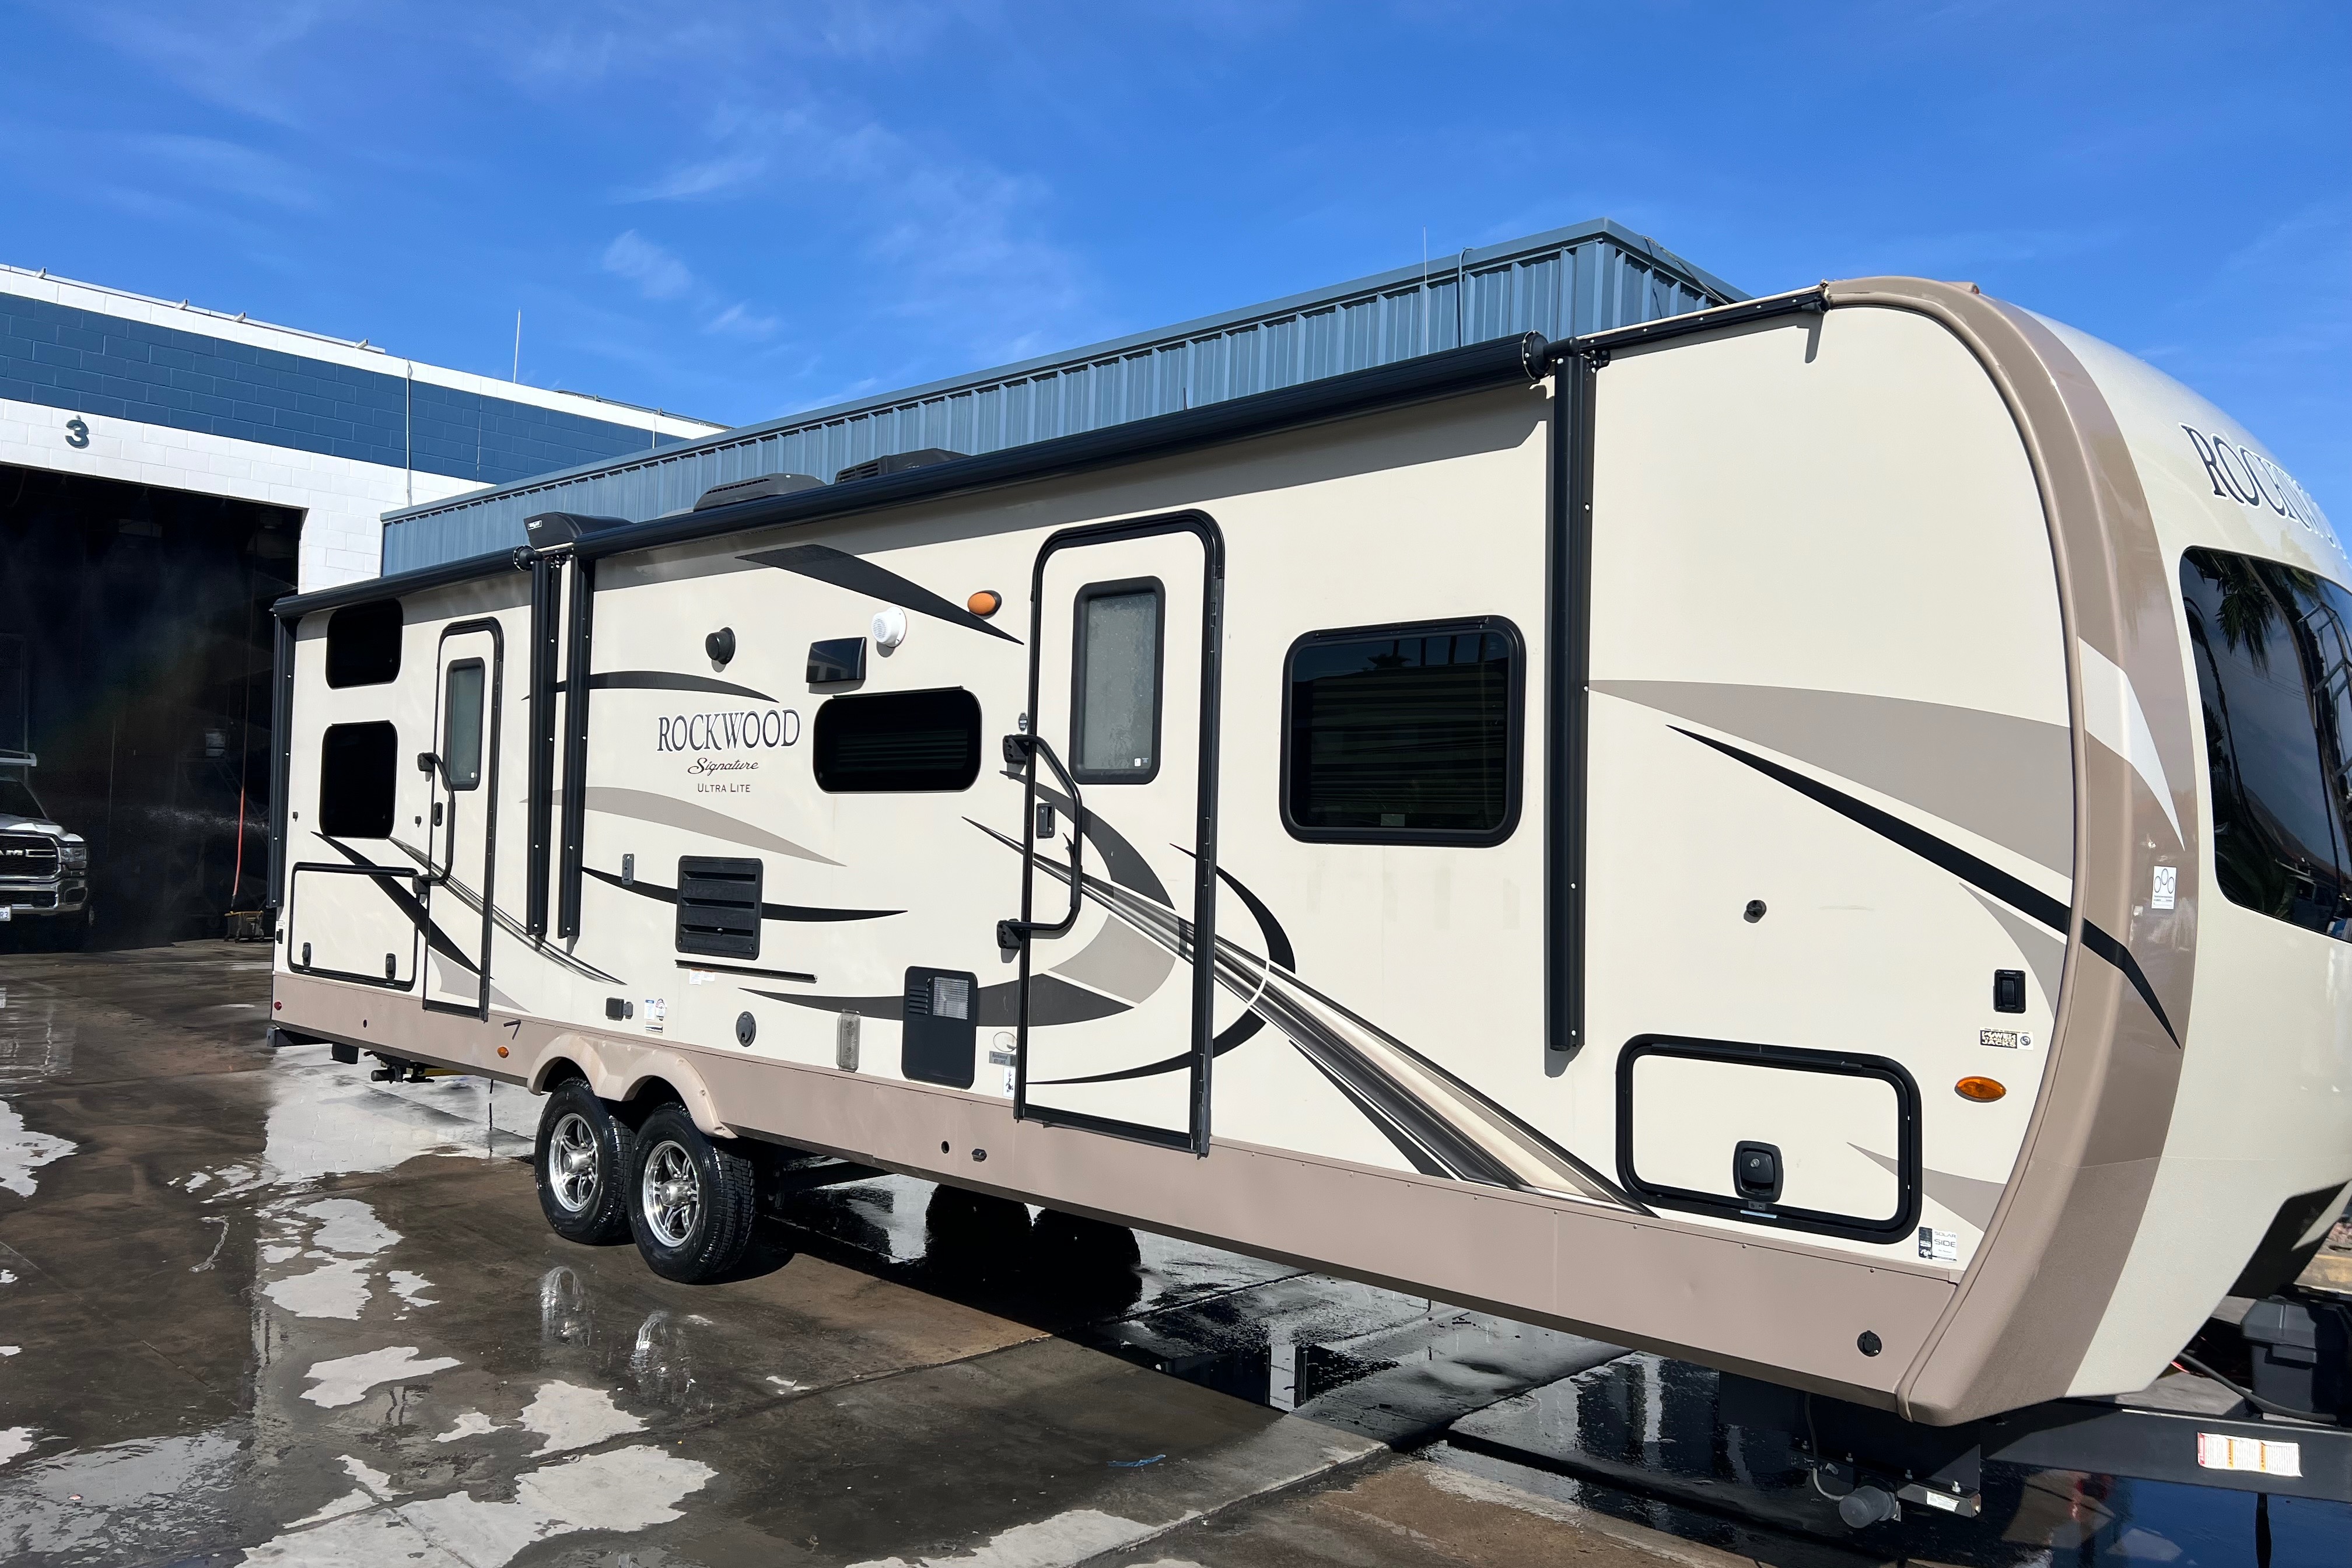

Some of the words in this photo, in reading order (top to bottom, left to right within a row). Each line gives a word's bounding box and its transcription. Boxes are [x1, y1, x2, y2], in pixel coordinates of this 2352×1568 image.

[65, 419, 89, 449] 3
[657, 709, 800, 752] ROCKWOOD
[687, 757, 759, 776] Signature
[698, 783, 726, 793] ULTRA
[730, 783, 751, 793] LITE
[1982, 1039, 2016, 1047] JACKS
[1934, 1238, 1957, 1248] SIDE
